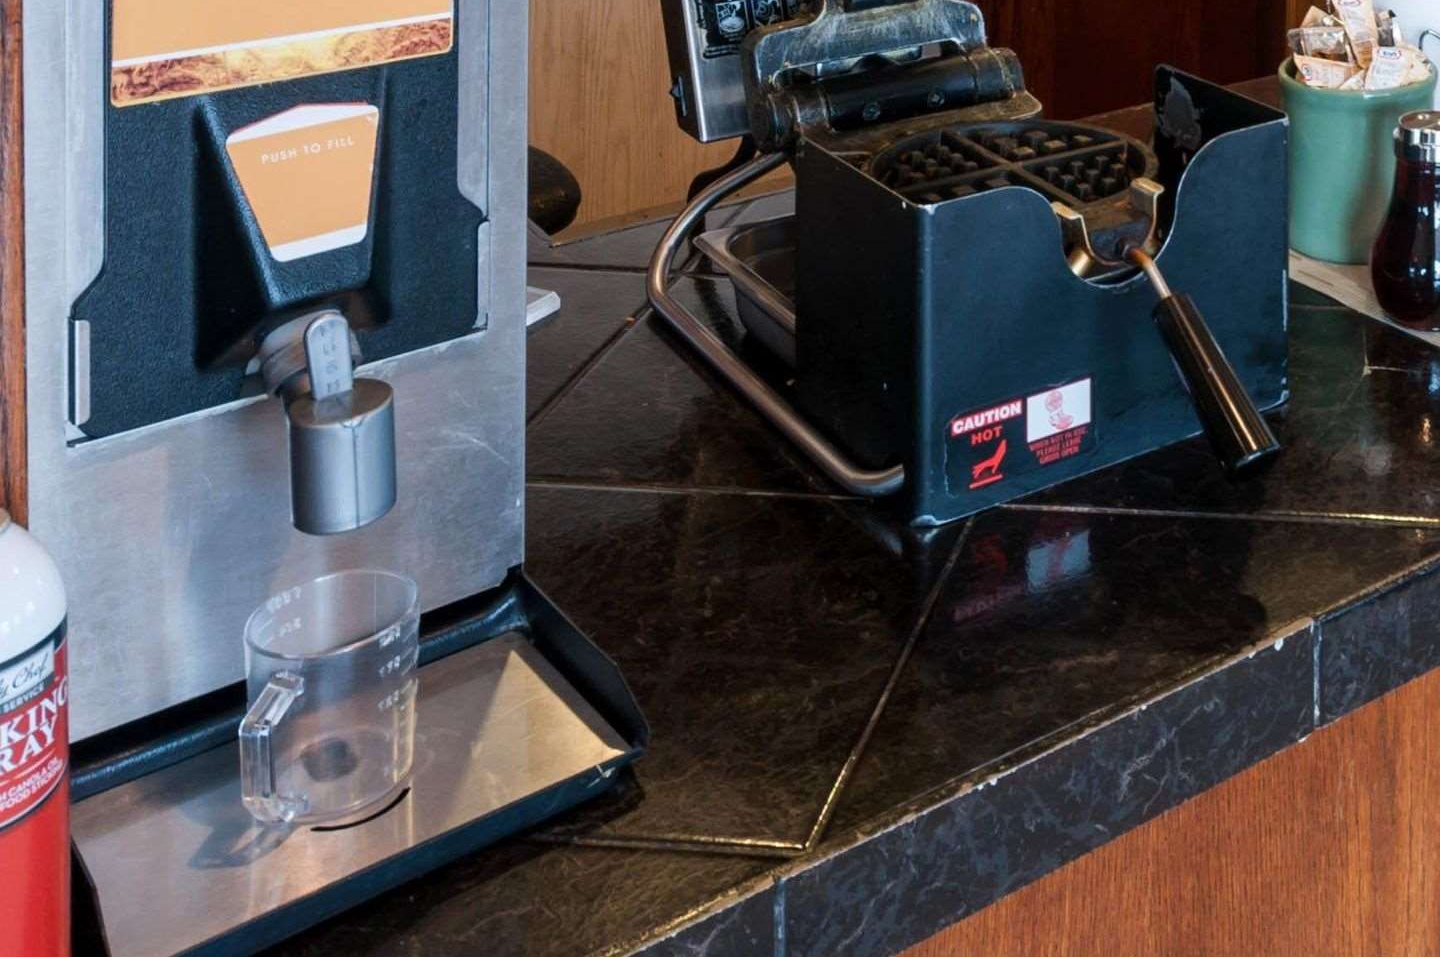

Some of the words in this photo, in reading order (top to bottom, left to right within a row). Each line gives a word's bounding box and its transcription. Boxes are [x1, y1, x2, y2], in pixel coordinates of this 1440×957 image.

[261, 147, 297, 165] PUSH
[303, 142, 321, 155] TO
[327, 135, 354, 150] FILL
[951, 400, 1023, 435] CAUTION
[971, 425, 1003, 446] HOT
[12, 652, 49, 689] Chef
